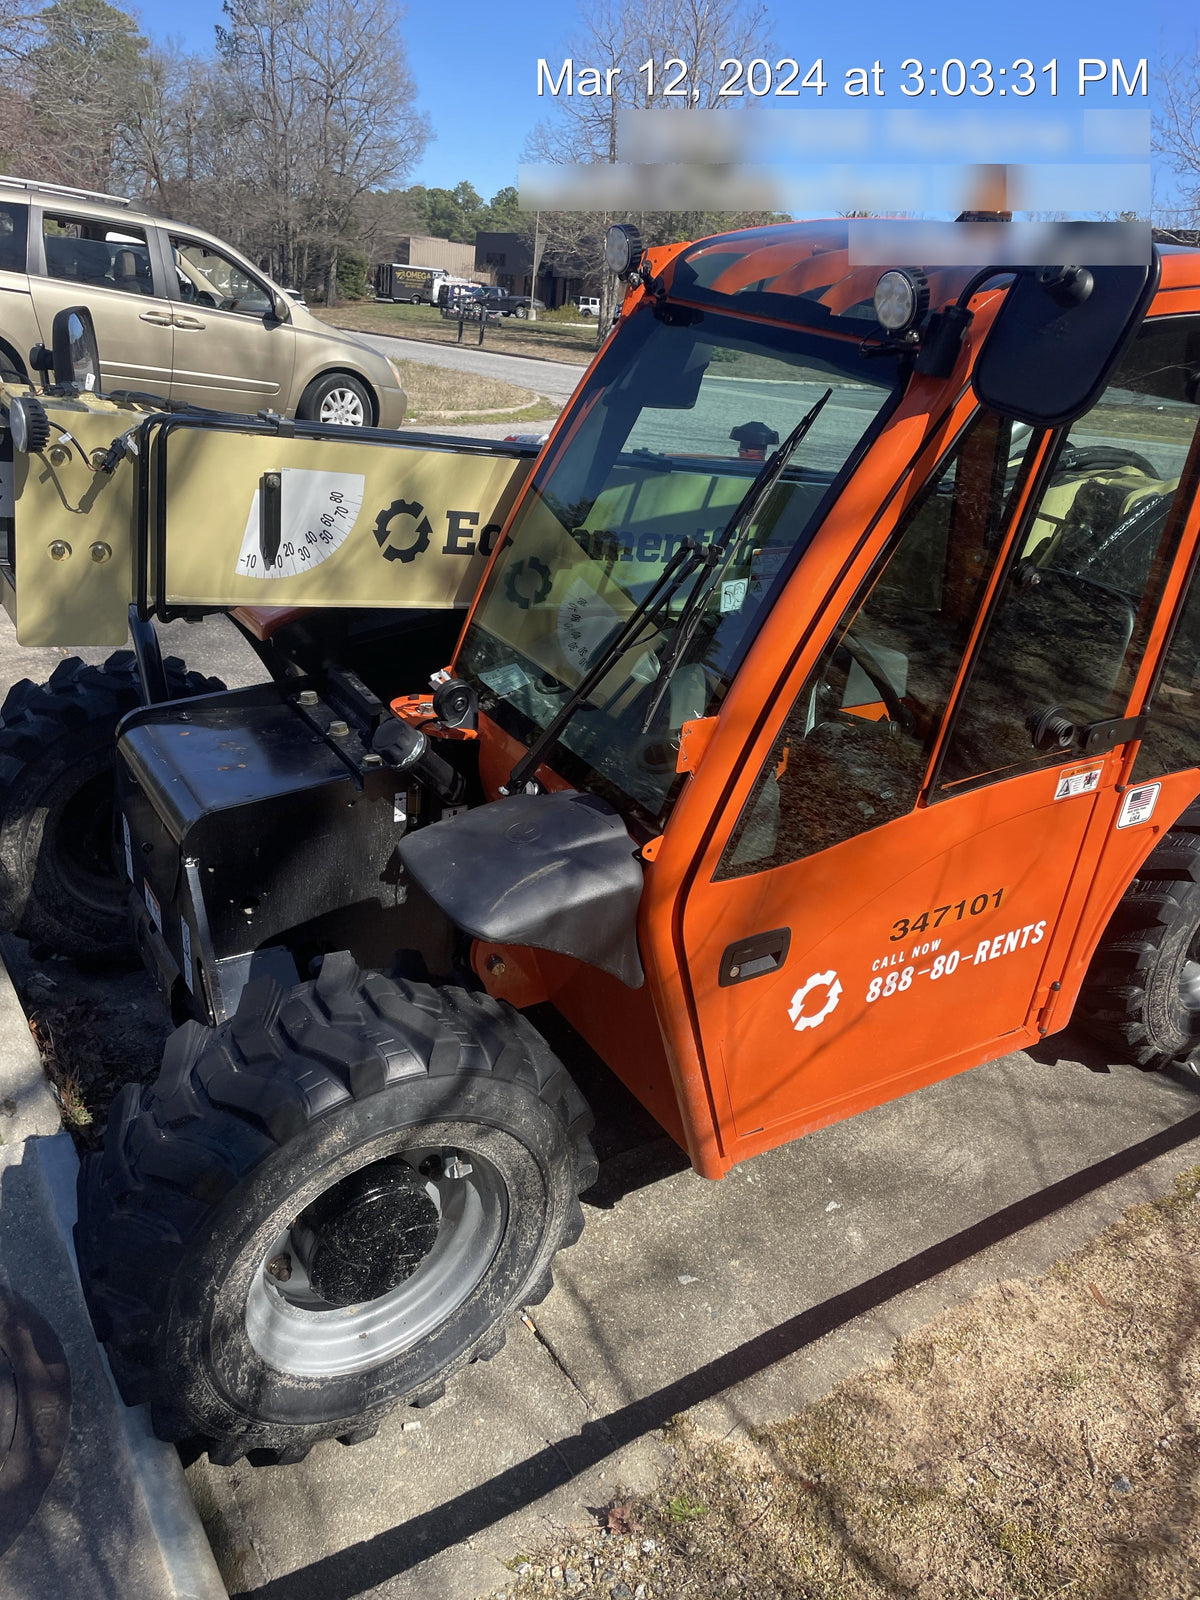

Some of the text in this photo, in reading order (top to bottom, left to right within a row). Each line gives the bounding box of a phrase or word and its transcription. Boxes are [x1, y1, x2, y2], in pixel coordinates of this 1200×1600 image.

[406, 271, 431, 280] OMEGA
[330, 491, 344, 503] 80
[334, 506, 349, 518] 70
[321, 514, 335, 527] 60
[305, 531, 318, 545] 40
[319, 530, 333, 544] 50
[283, 542, 295, 557] 20
[298, 547, 311, 561] 30
[240, 554, 257, 568] -10
[890, 888, 1004, 941] 347101
[866, 920, 1047, 1003] 888-80-RENTS
[872, 938, 942, 971] CALL NOW
